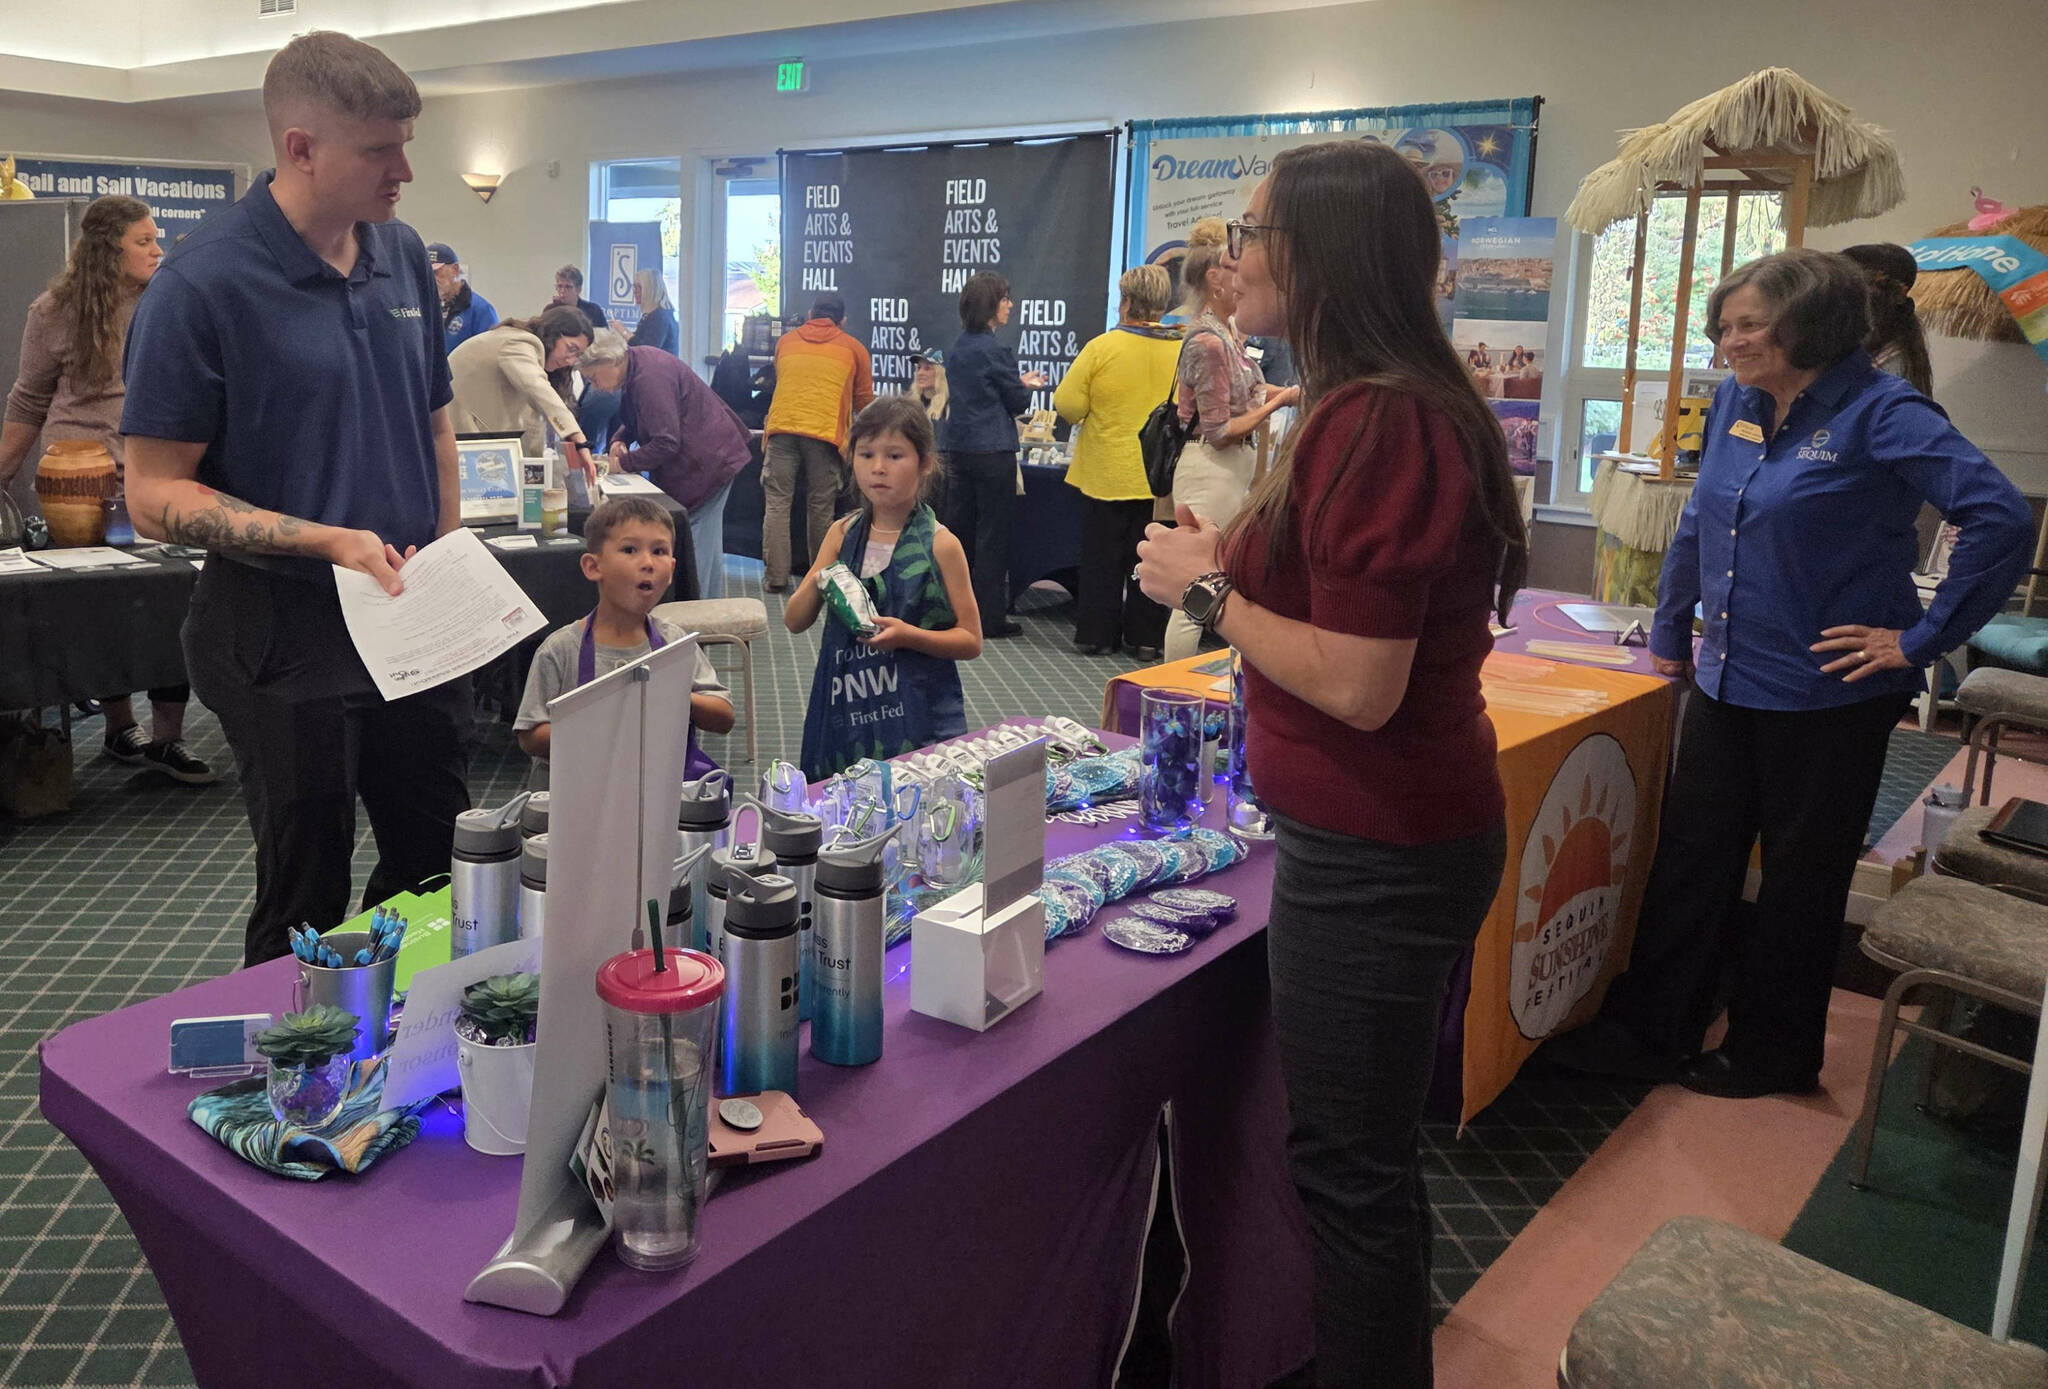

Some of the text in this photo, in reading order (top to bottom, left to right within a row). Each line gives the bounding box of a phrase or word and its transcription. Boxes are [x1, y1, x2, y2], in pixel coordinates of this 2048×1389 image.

[778, 63, 803, 91] EXIT
[57, 174, 93, 194] and
[97, 176, 131, 197] Sail
[135, 177, 226, 200] Vacations
[806, 185, 840, 208] FIELD
[946, 178, 987, 205] FIELD
[804, 212, 852, 236] ARTS &
[944, 208, 999, 234] ARTS &
[1167, 217, 1190, 230] Travel
[804, 240, 853, 263] EVENTS
[943, 238, 1000, 264] EVENTS
[1472, 236, 1521, 245] NORWEGIAN
[802, 268, 838, 291] HALL
[870, 298, 908, 322] FIELD
[1020, 300, 1066, 326] FIELD
[871, 327, 921, 350] ARTS &
[1018, 331, 1078, 357] ARTS &
[872, 354, 912, 379] EVENT
[1796, 449, 1838, 462] SEQUIM
[831, 664, 899, 705] PNW
[851, 701, 904, 727] First Fed
[818, 950, 851, 970] Trust
